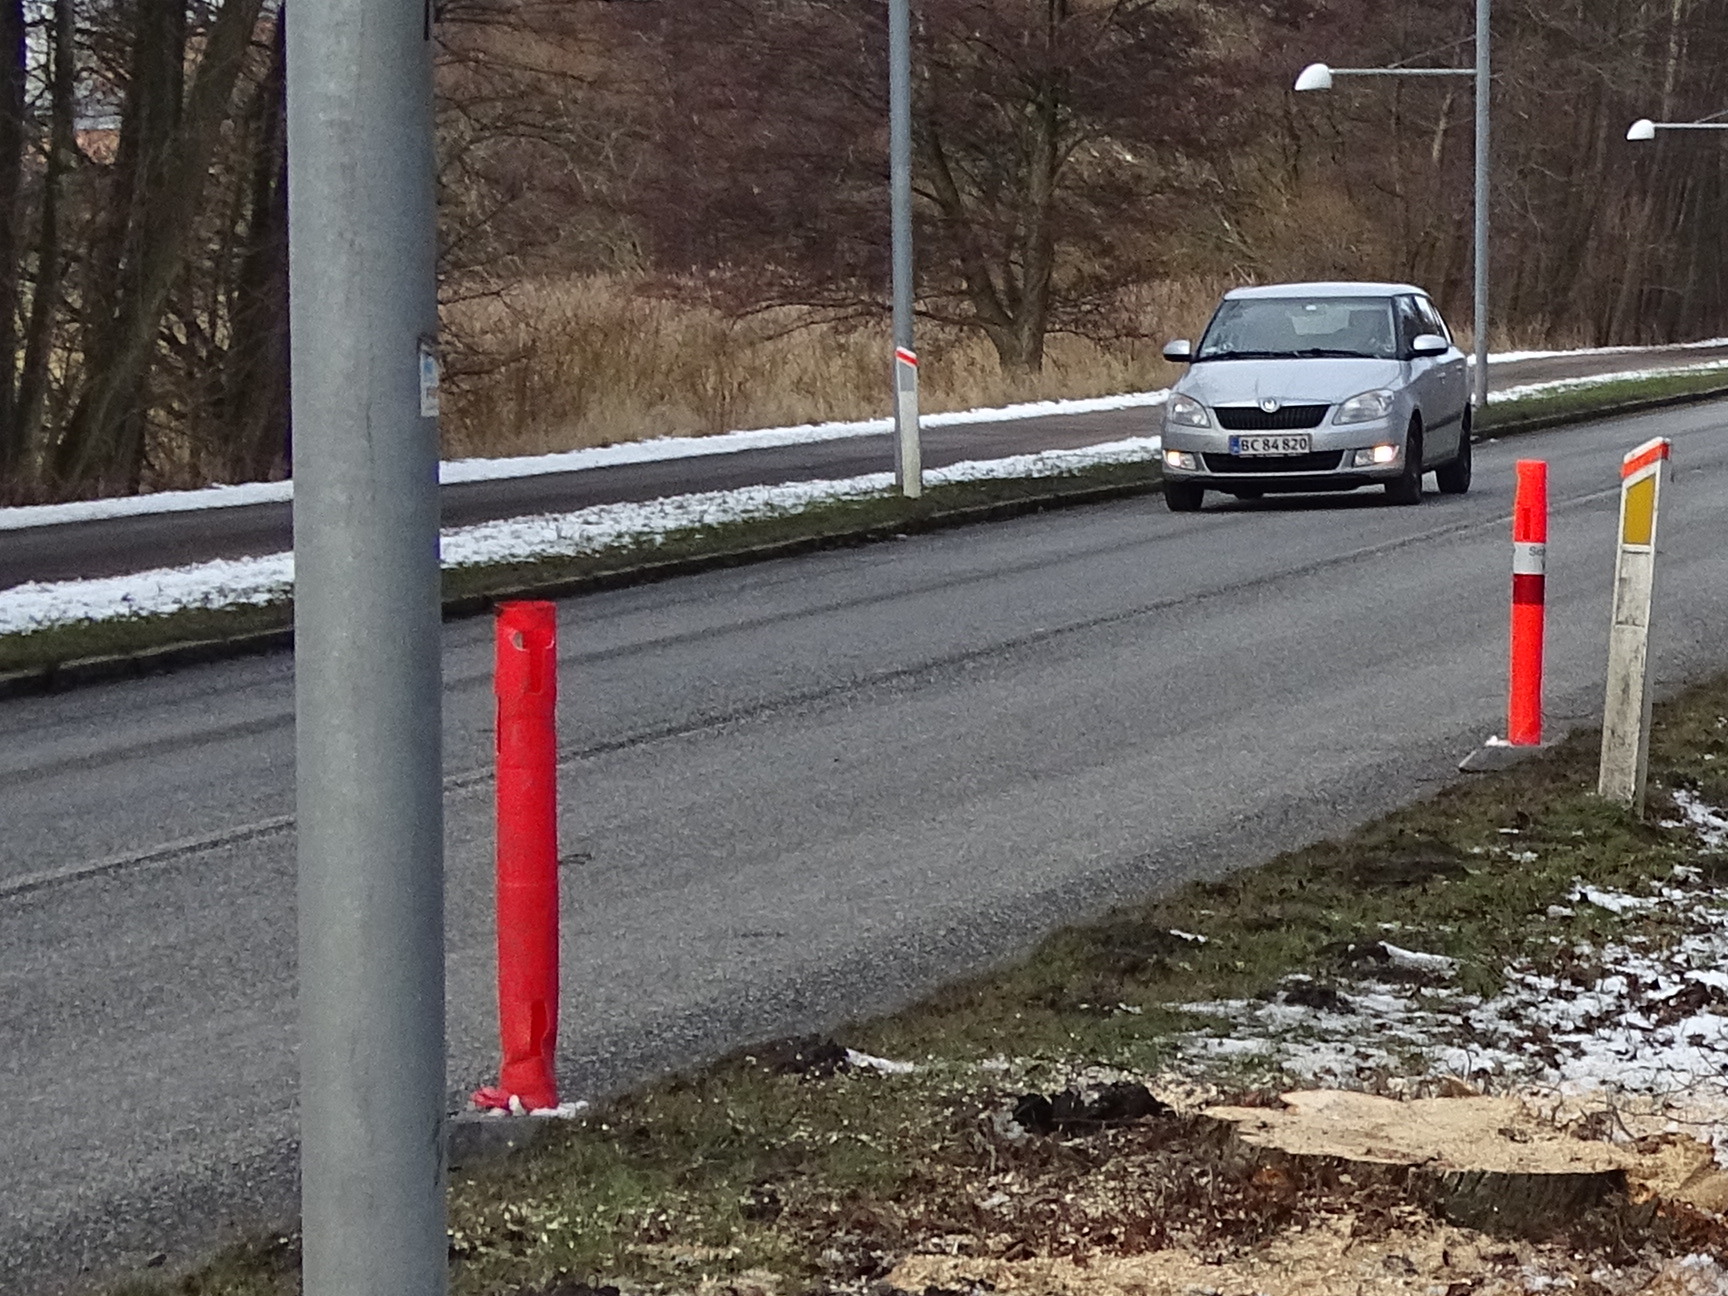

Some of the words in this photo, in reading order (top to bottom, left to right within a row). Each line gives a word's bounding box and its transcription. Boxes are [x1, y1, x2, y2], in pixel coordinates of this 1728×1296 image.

[1240, 439, 1260, 452] BC
[1262, 438, 1280, 452] 84
[1282, 437, 1308, 451] 820
